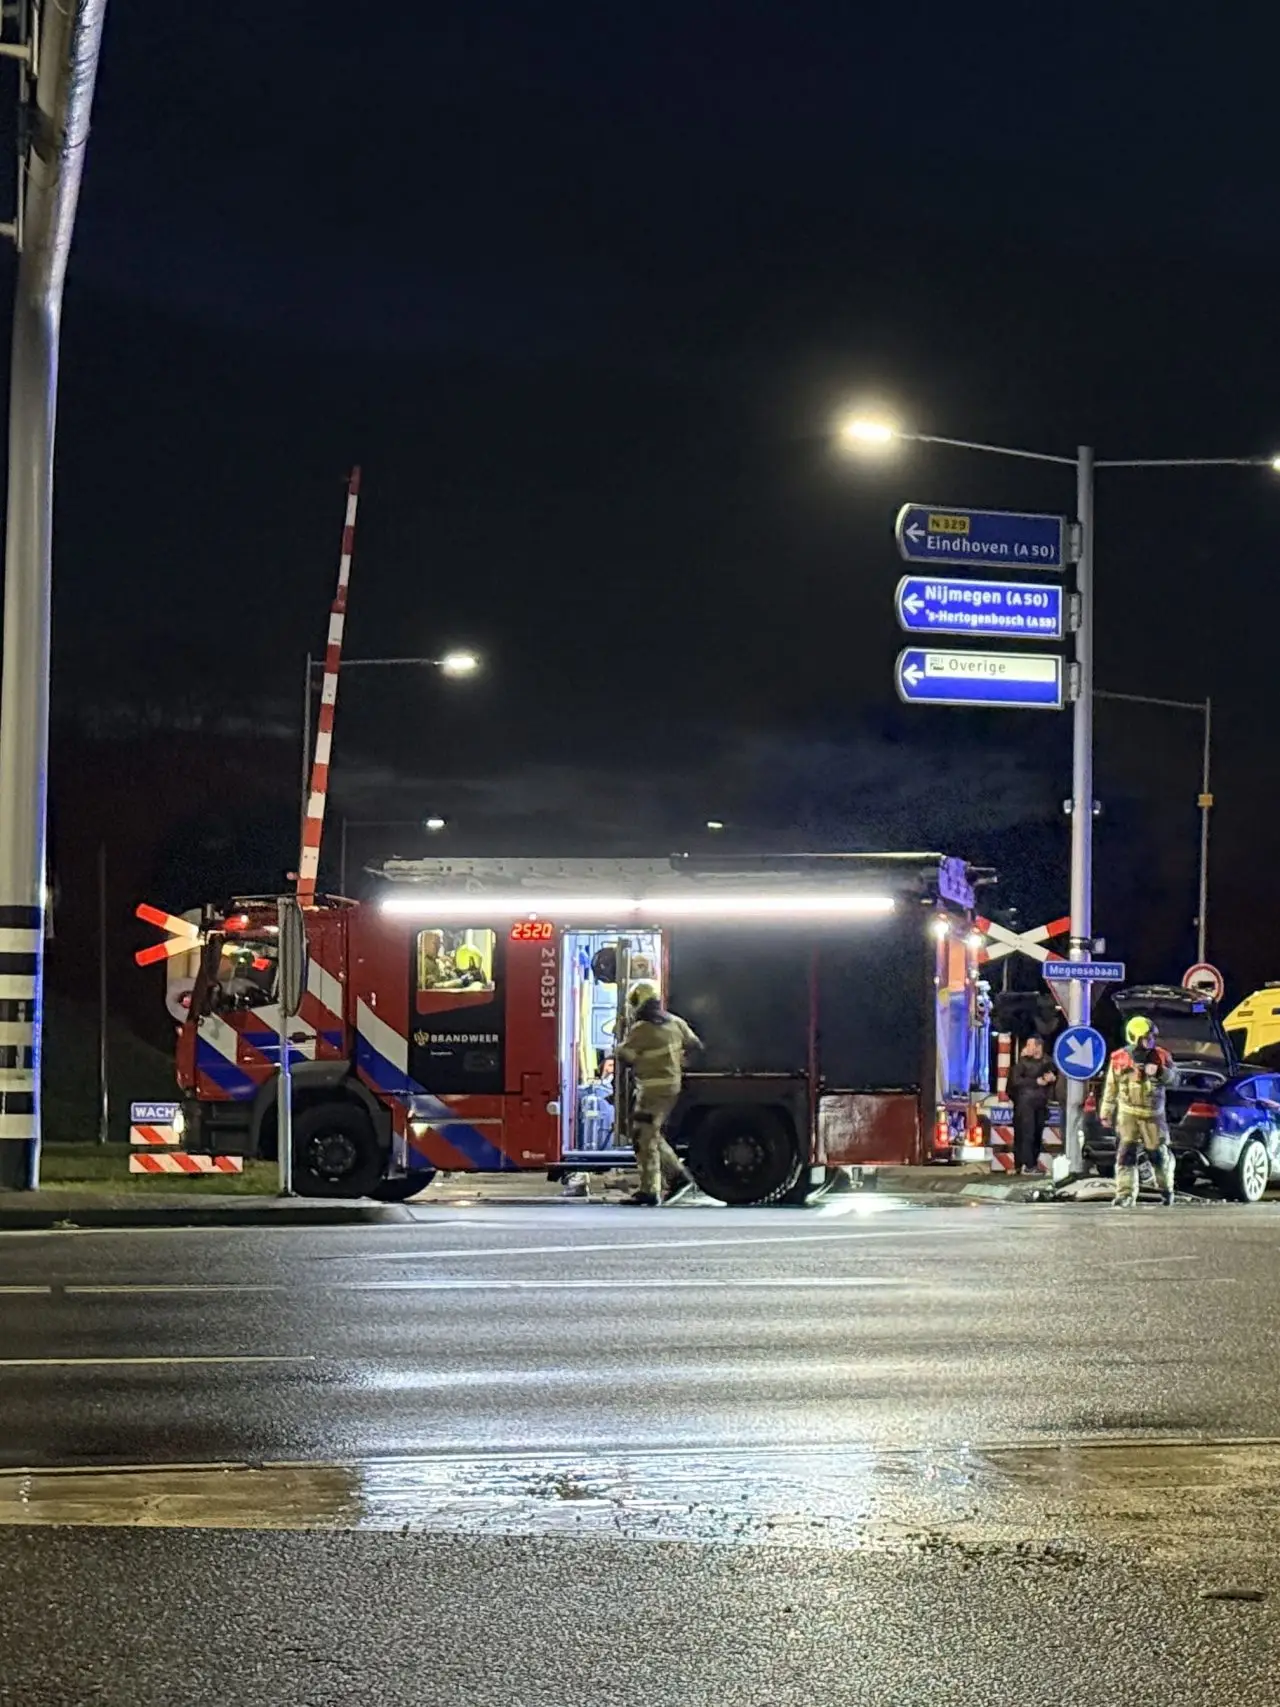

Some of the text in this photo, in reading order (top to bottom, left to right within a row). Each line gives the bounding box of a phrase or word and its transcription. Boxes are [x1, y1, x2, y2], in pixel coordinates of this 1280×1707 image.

[926, 535, 1008, 554] Eindhoven
[925, 585, 1001, 607] Nijmegen
[948, 659, 1006, 676] Overige
[511, 923, 553, 938] 2520
[1049, 965, 1119, 976] Megensebaan
[541, 947, 556, 1017] 21-0331
[430, 1034, 499, 1043] BRANDWEER
[134, 1106, 176, 1118] WACH
